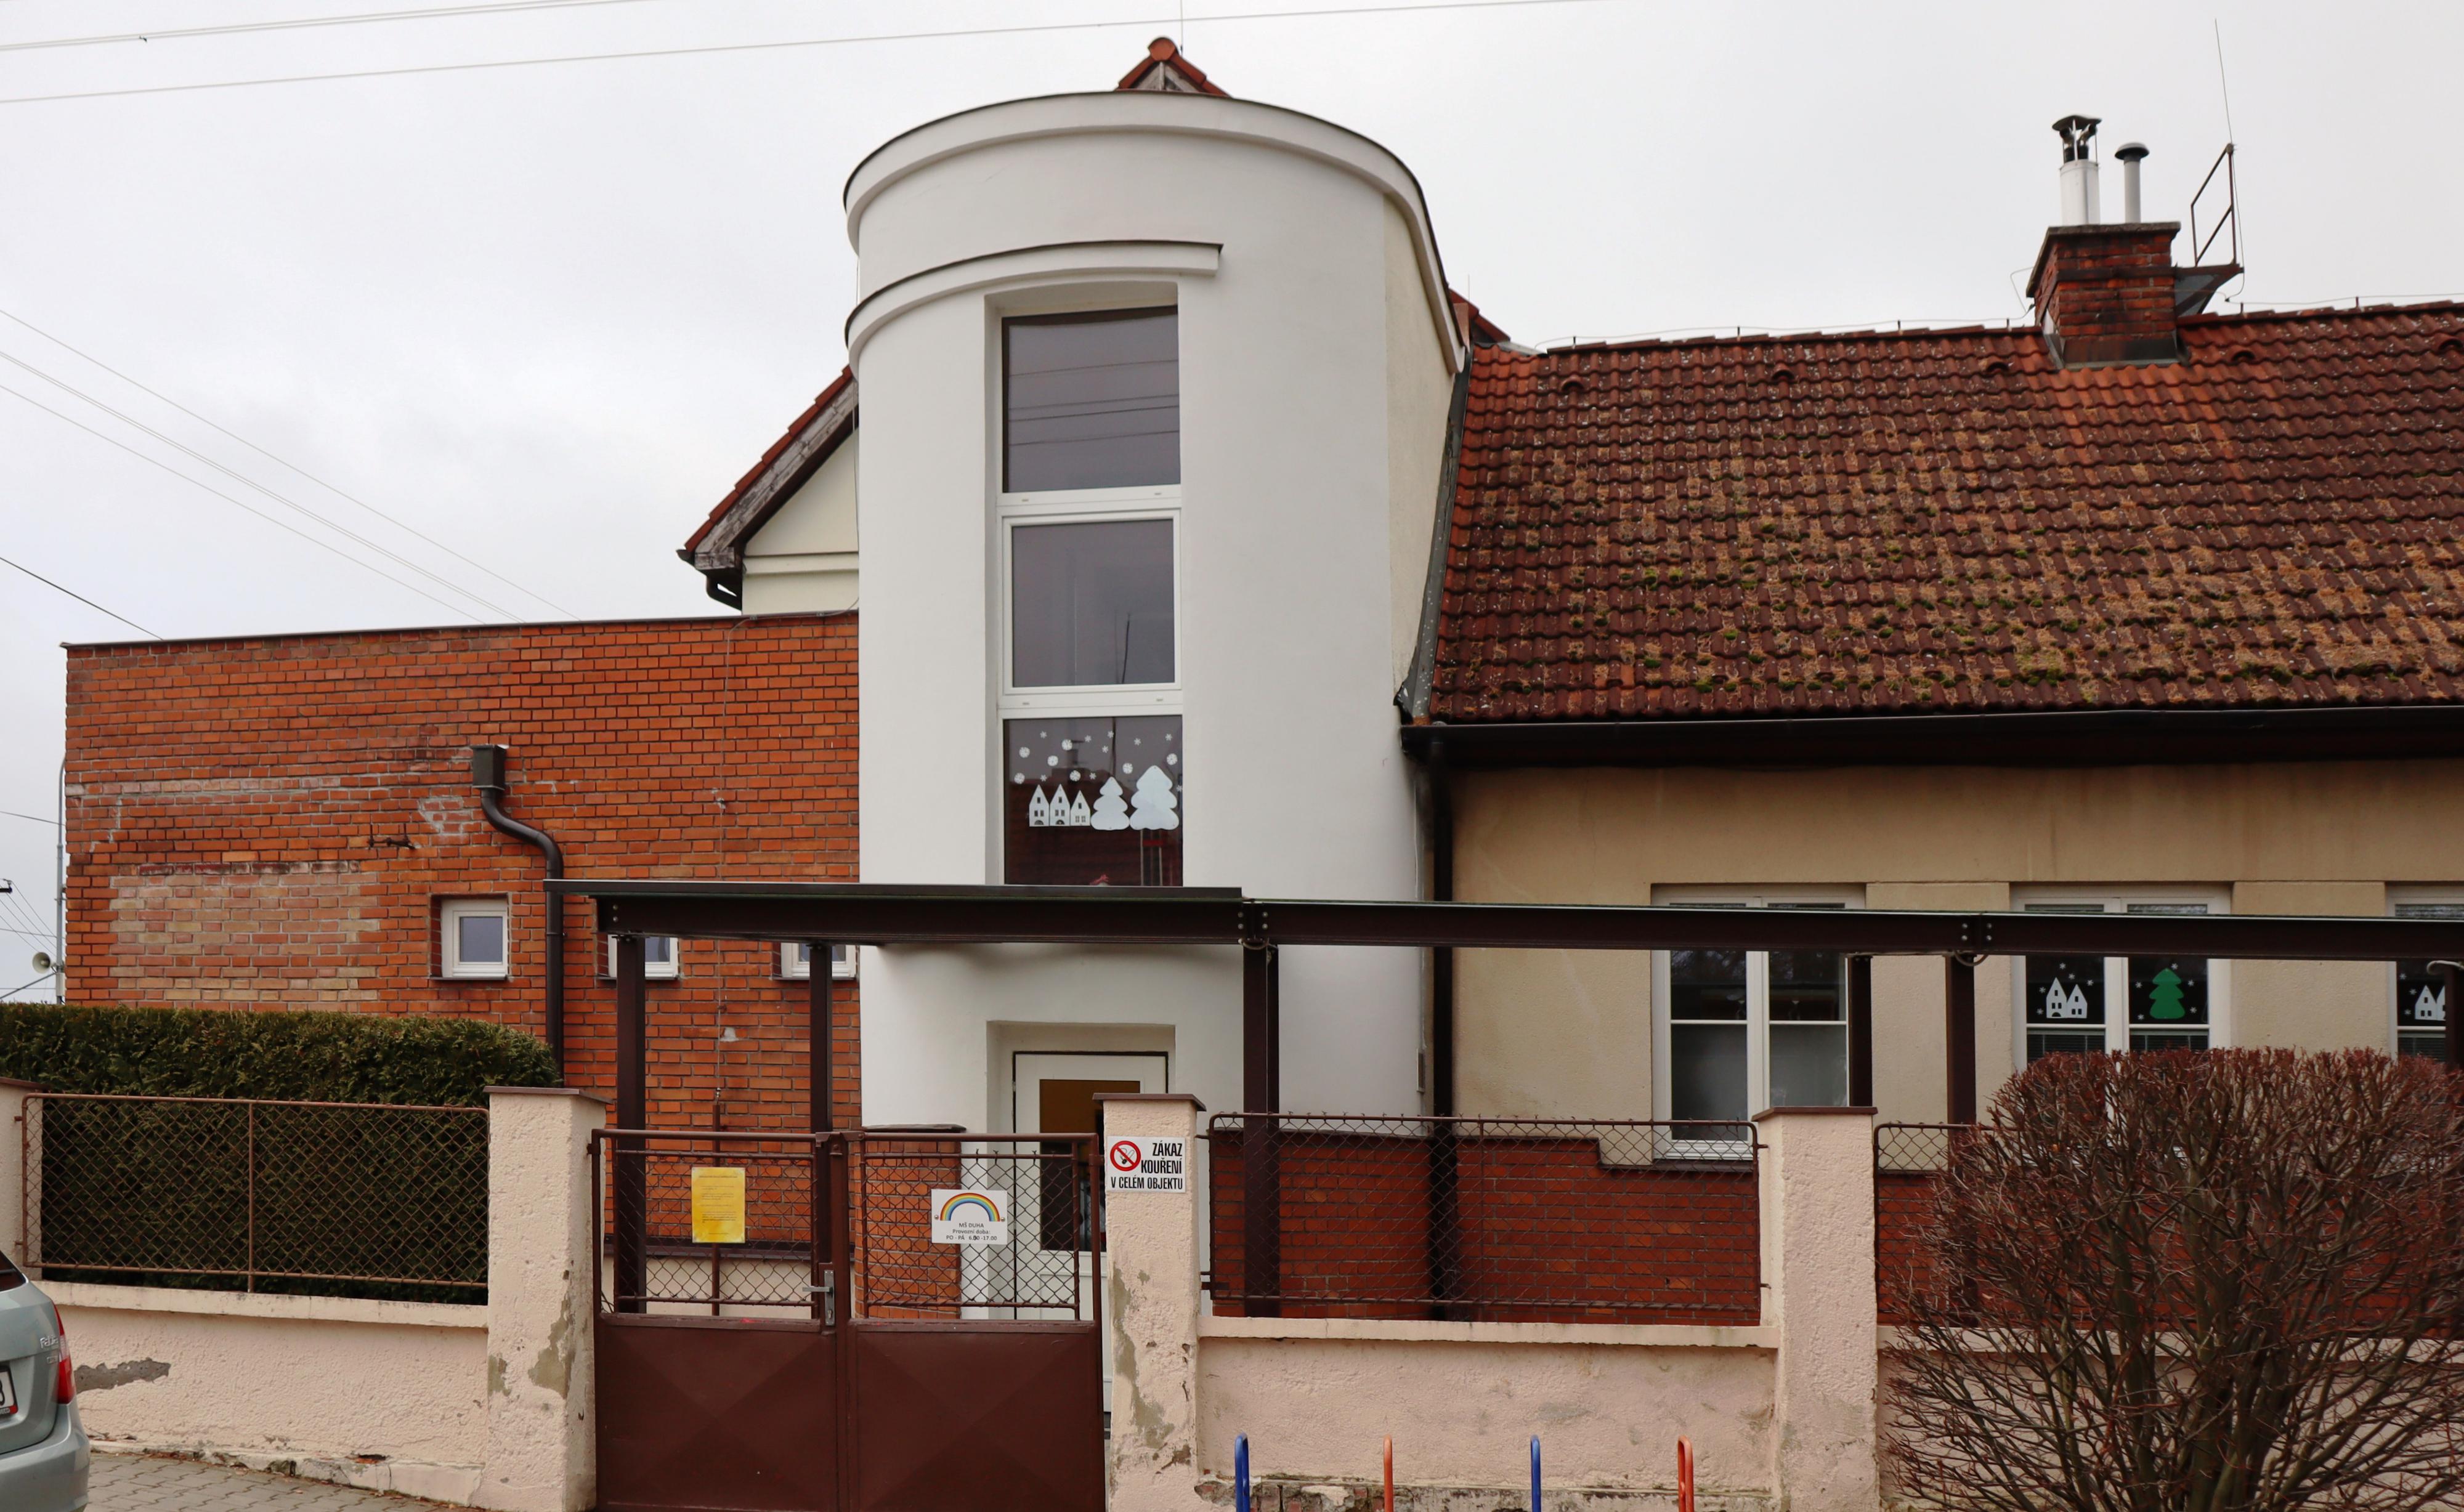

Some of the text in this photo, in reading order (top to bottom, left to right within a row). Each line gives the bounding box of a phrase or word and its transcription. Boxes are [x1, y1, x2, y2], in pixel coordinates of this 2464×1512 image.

[1153, 1141, 1182, 1157] ZÁKAZ
[1141, 1158, 1182, 1174] KOUŘENÍ
[1111, 1175, 1183, 1190] V CELÉM OBJEKTU
